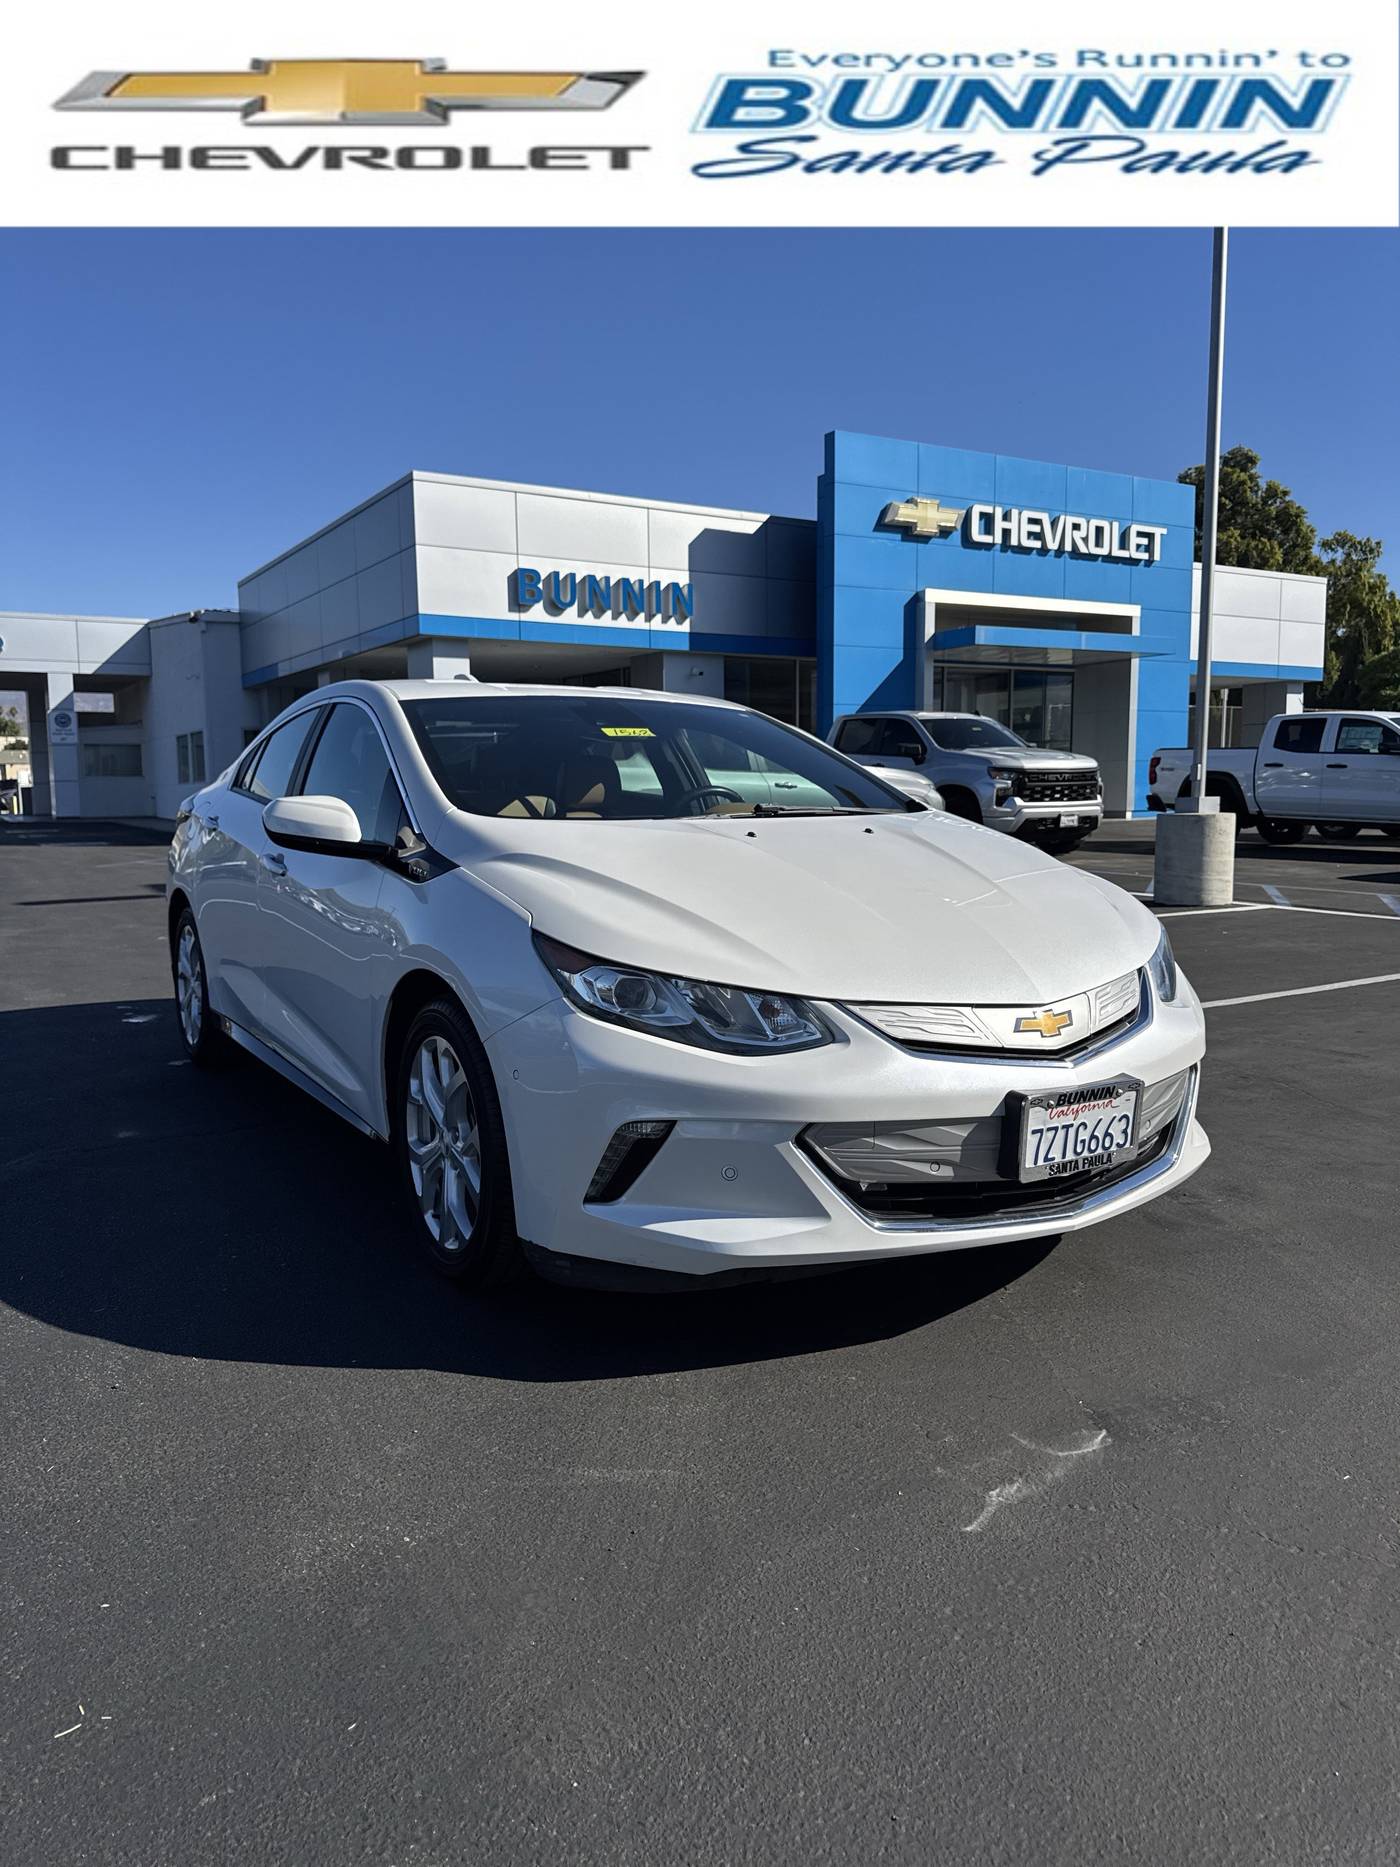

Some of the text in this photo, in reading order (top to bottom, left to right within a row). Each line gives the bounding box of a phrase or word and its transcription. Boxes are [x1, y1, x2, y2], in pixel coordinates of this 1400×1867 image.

[966, 504, 1169, 562] CHEVROLET
[508, 567, 694, 625] BUNNIN
[1048, 1098, 1120, 1121] California
[1056, 1085, 1116, 1107] BUNNIN
[1031, 1114, 1131, 1166] 7ZTG663
[1049, 1152, 1113, 1176] SANTA PAULA
